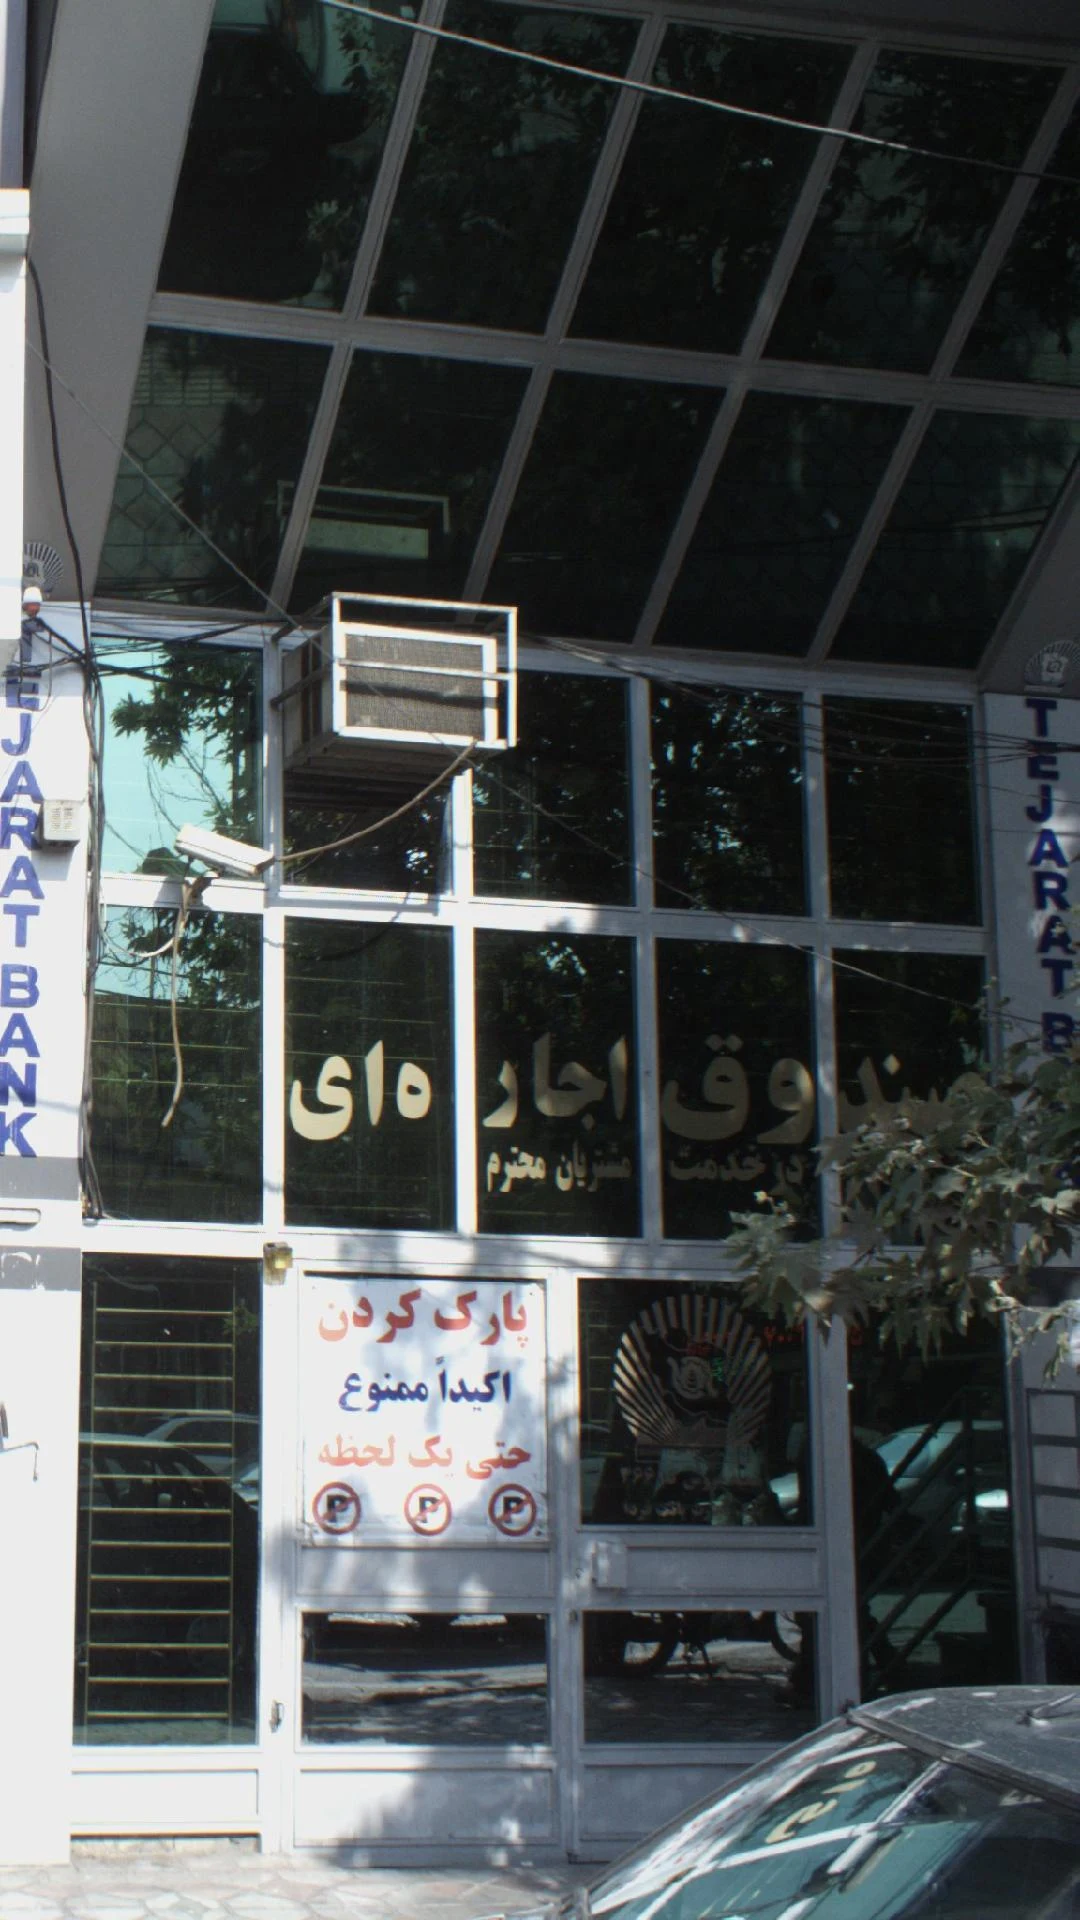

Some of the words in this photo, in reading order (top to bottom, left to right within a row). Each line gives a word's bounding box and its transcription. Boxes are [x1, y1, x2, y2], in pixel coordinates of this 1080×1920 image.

[0, 618, 44, 950] TEJARAT
[1025, 698, 1076, 998] TEJARAT
[0, 964, 40, 1159] BANK
[486, 1145, 547, 1193] محترم
[555, 1140, 632, 1192] مشتریان
[669, 1144, 766, 1181] خدمت
[318, 1288, 421, 1343] کردن
[434, 1290, 529, 1348] پارک
[338, 1372, 429, 1412] ممنوع
[318, 1433, 396, 1468] لحظه
[408, 1435, 453, 1478] یک
[465, 1441, 531, 1480] حتی
